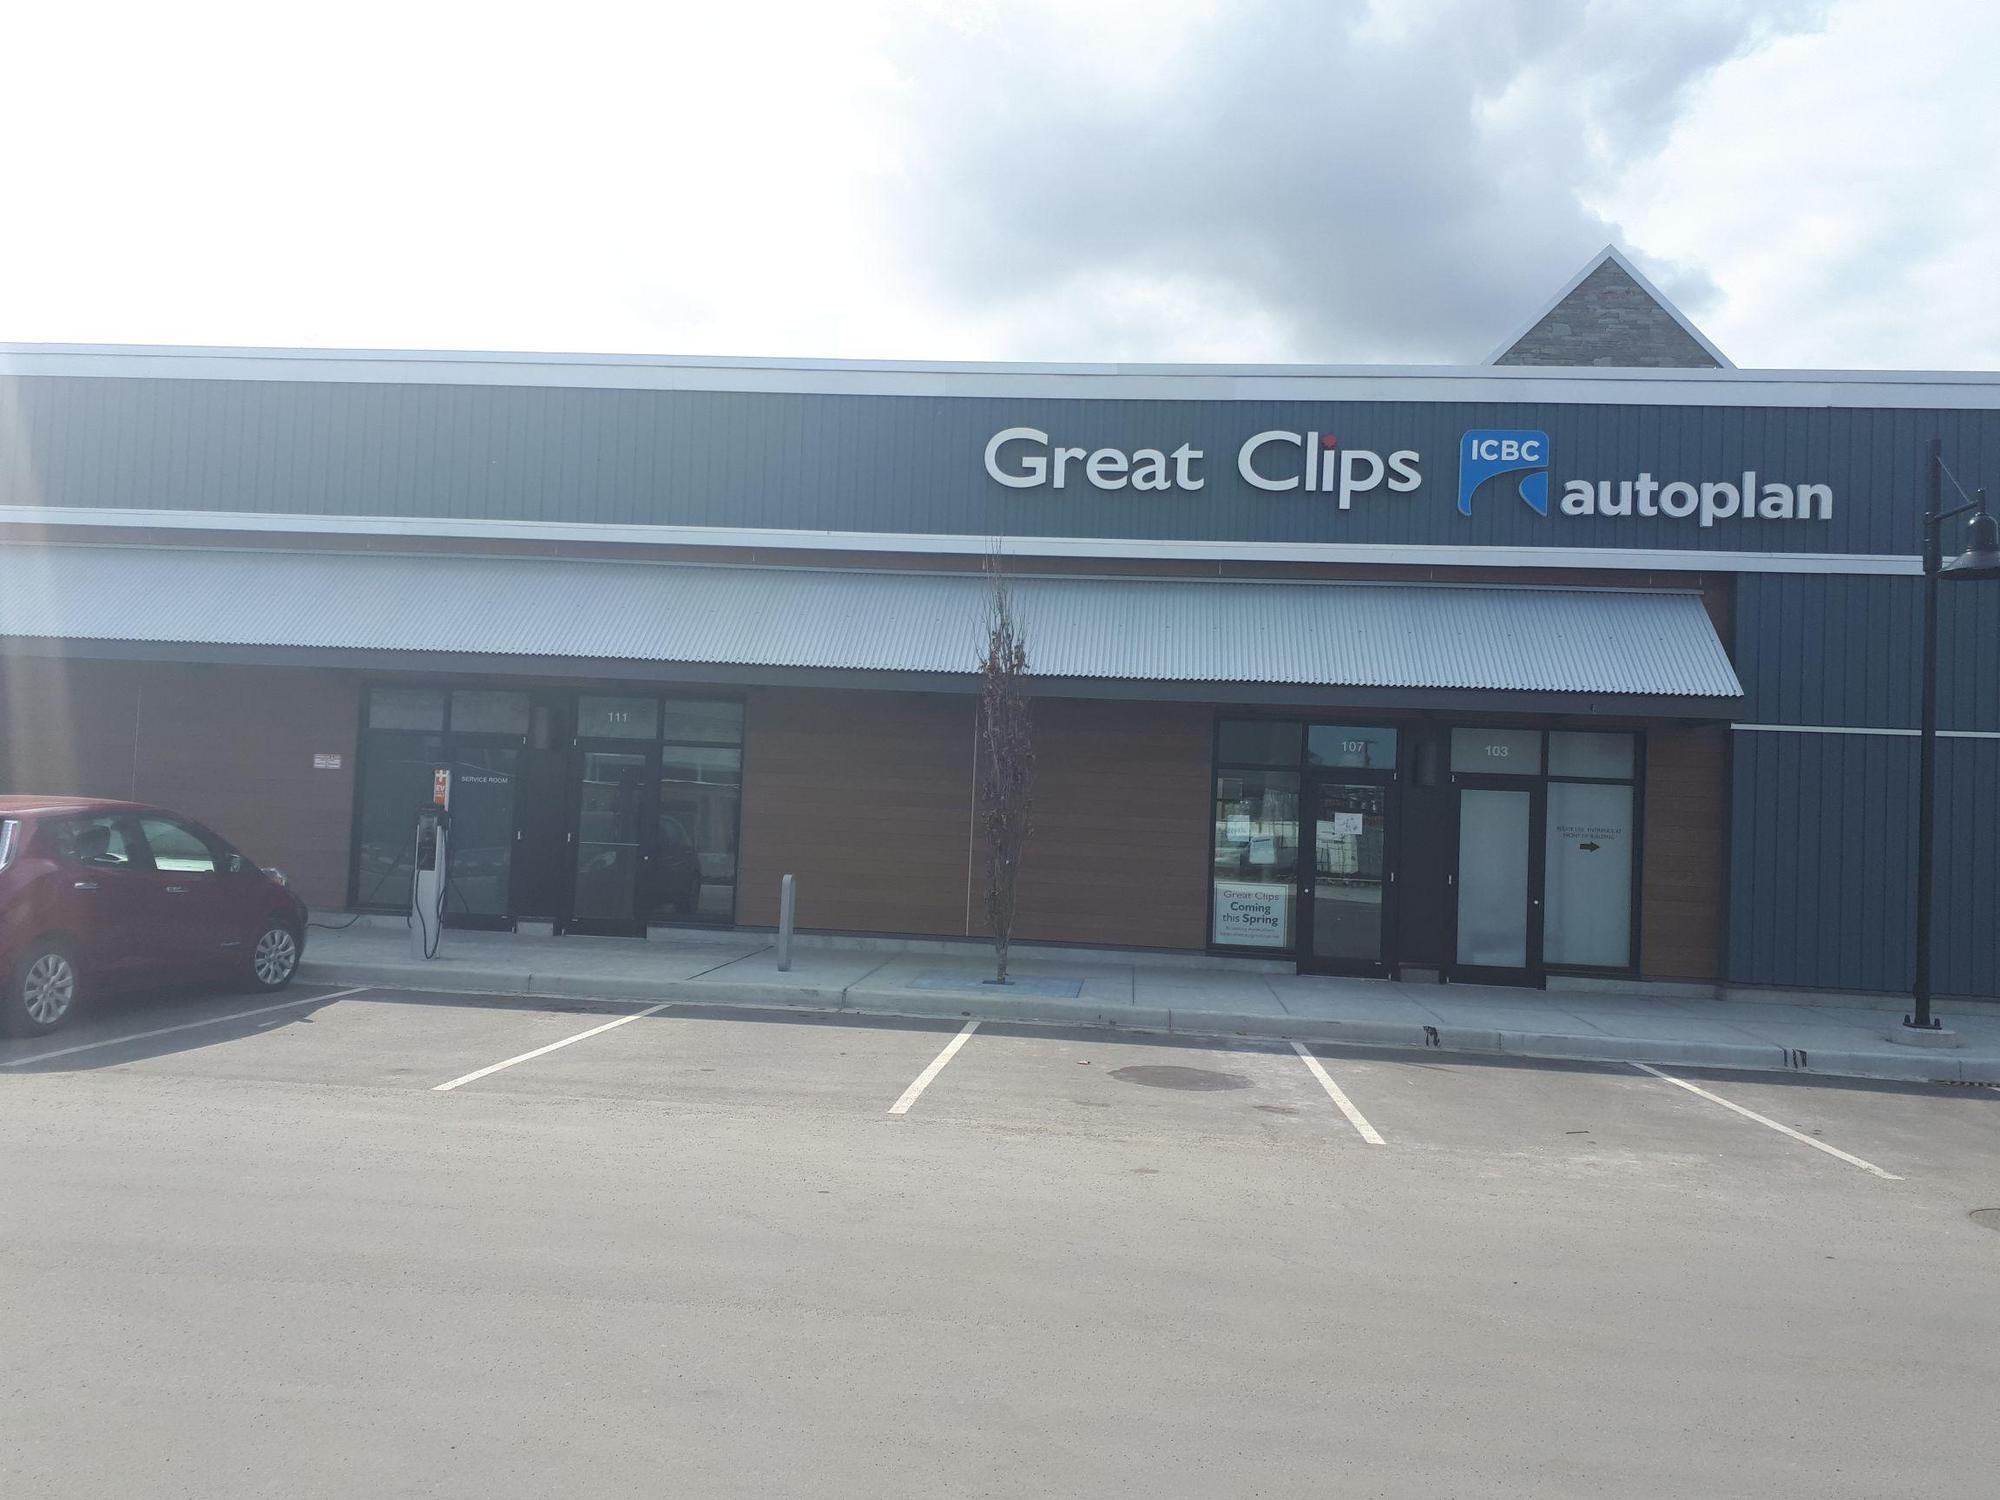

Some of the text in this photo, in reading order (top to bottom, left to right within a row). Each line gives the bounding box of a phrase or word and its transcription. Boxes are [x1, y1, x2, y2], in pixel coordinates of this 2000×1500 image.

[1471, 439, 1541, 462] ICBC
[984, 427, 1422, 510] Great Clips
[1559, 471, 1833, 528] autoplan
[608, 712, 628, 723] 111
[1341, 741, 1364, 752] 107
[1485, 745, 1509, 757] 103
[1223, 890, 1280, 902] Great Clips
[1230, 901, 1272, 915] Coming
[1222, 912, 1279, 927] this Spring
